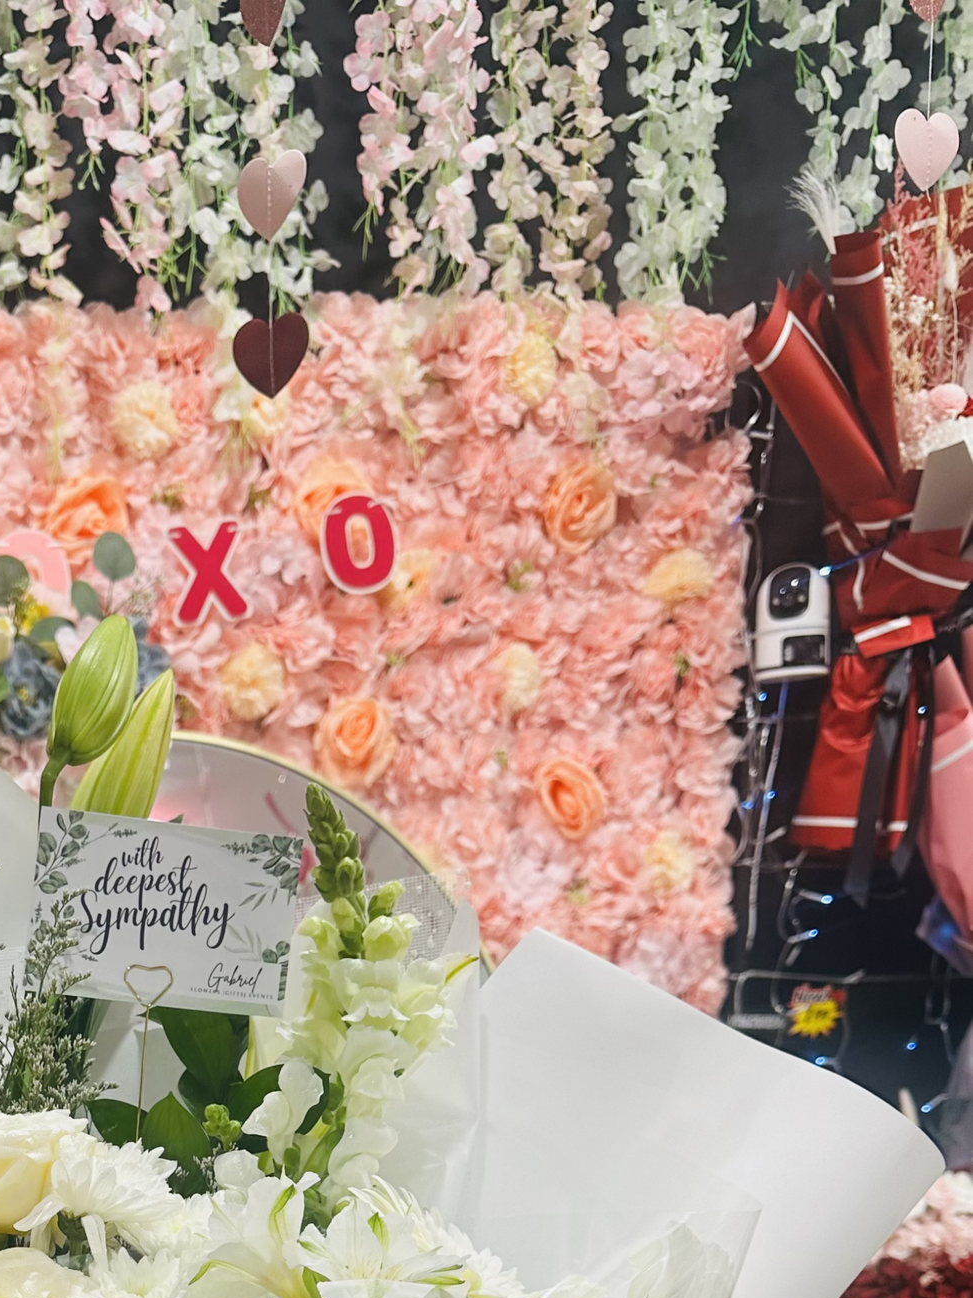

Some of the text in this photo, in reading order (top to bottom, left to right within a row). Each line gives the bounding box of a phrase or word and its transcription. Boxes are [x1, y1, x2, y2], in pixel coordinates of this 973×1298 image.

[121, 836, 165, 871] with
[94, 855, 198, 912] deepest
[80, 883, 235, 955] Sympathy
[207, 962, 263, 995] Gabriel
